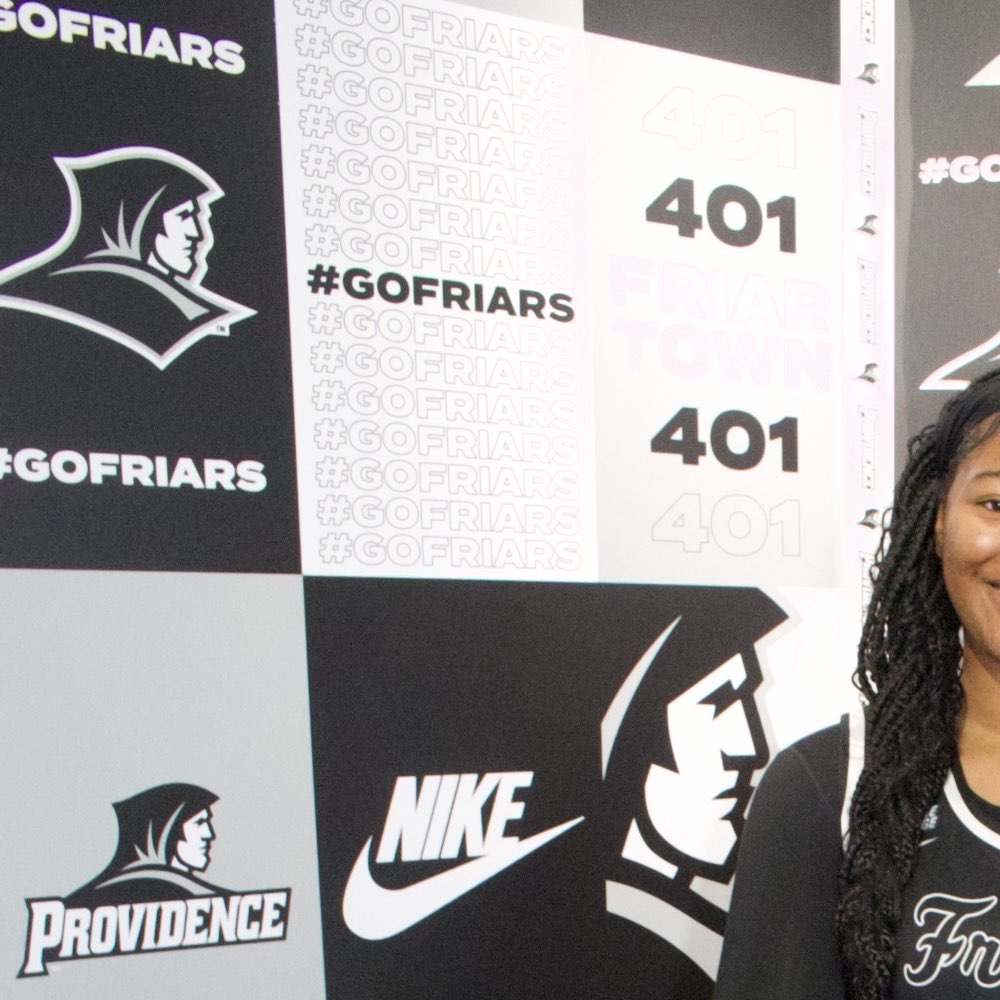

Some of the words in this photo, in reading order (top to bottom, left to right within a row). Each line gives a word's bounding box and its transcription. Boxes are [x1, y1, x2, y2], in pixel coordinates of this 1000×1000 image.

[295, 24, 567, 103] #GOFRIARS
[642, 85, 798, 170] 401
[645, 176, 798, 254] 401
[307, 263, 575, 322] #GOFRIARS
[608, 254, 832, 335] FRIAR
[611, 317, 833, 392] TOWN
[312, 380, 577, 430] #GOFRIARS
[314, 418, 578, 465] #GOFRIARS
[650, 406, 799, 473] 401
[316, 457, 580, 500] #GOFRIARS
[317, 495, 582, 536] #GOFRIARS
[650, 491, 801, 558] 401
[319, 532, 582, 571] #GOFRIARS
[376, 771, 534, 864] NIKE
[20, 889, 290, 977] PROVIDENCE
